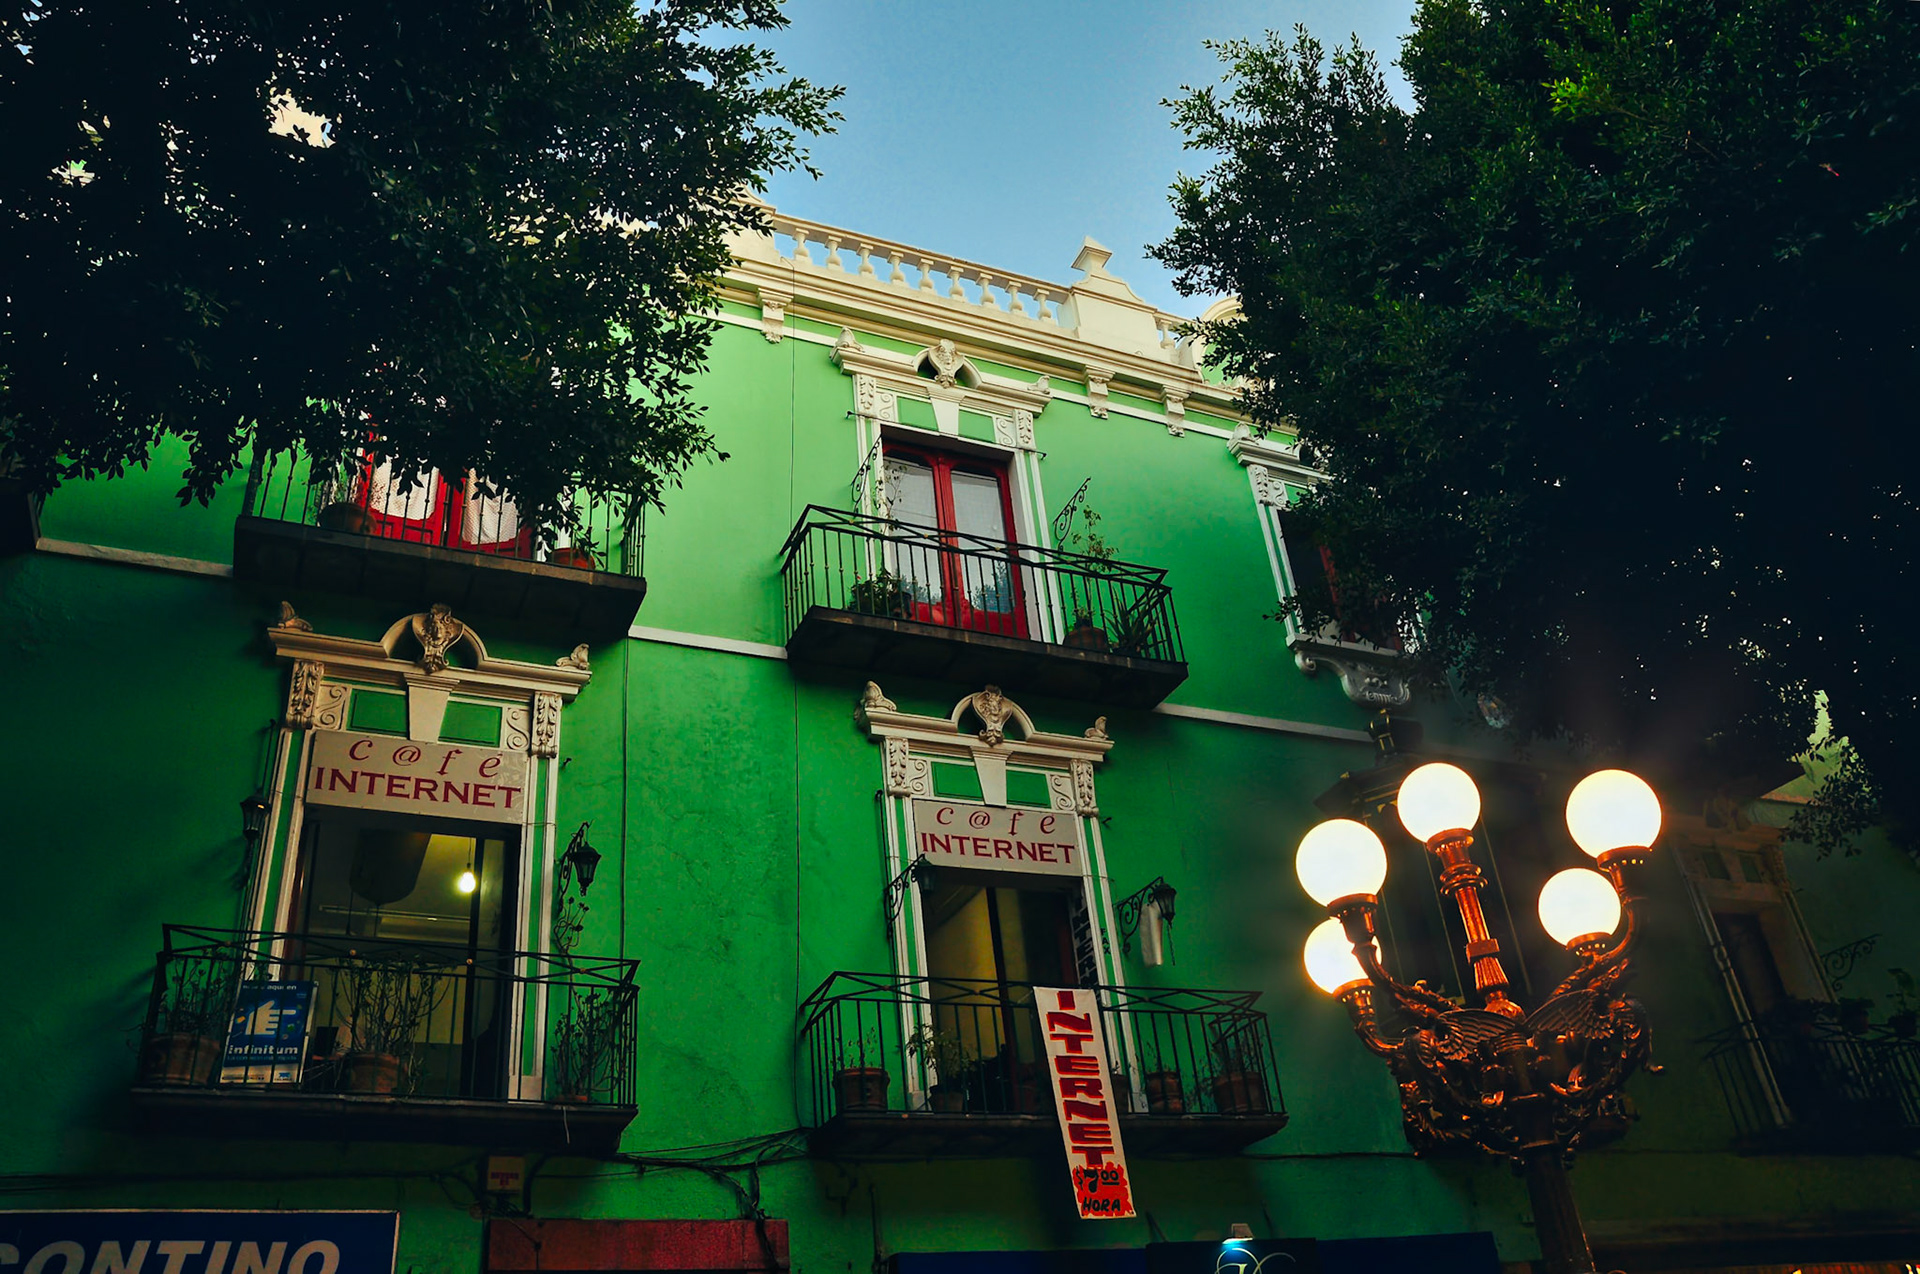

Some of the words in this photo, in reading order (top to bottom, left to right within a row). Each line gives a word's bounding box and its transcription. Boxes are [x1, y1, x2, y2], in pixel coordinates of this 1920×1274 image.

[314, 766, 522, 808] INTERNET
[920, 832, 1075, 864] INTERNET
[1100, 928, 1111, 954] FAX
[228, 1045, 298, 1054] infinitum
[1046, 991, 1115, 1168] INTERNET
[1083, 1197, 1120, 1211] HORA
[0, 1240, 340, 1274] ONTINO
